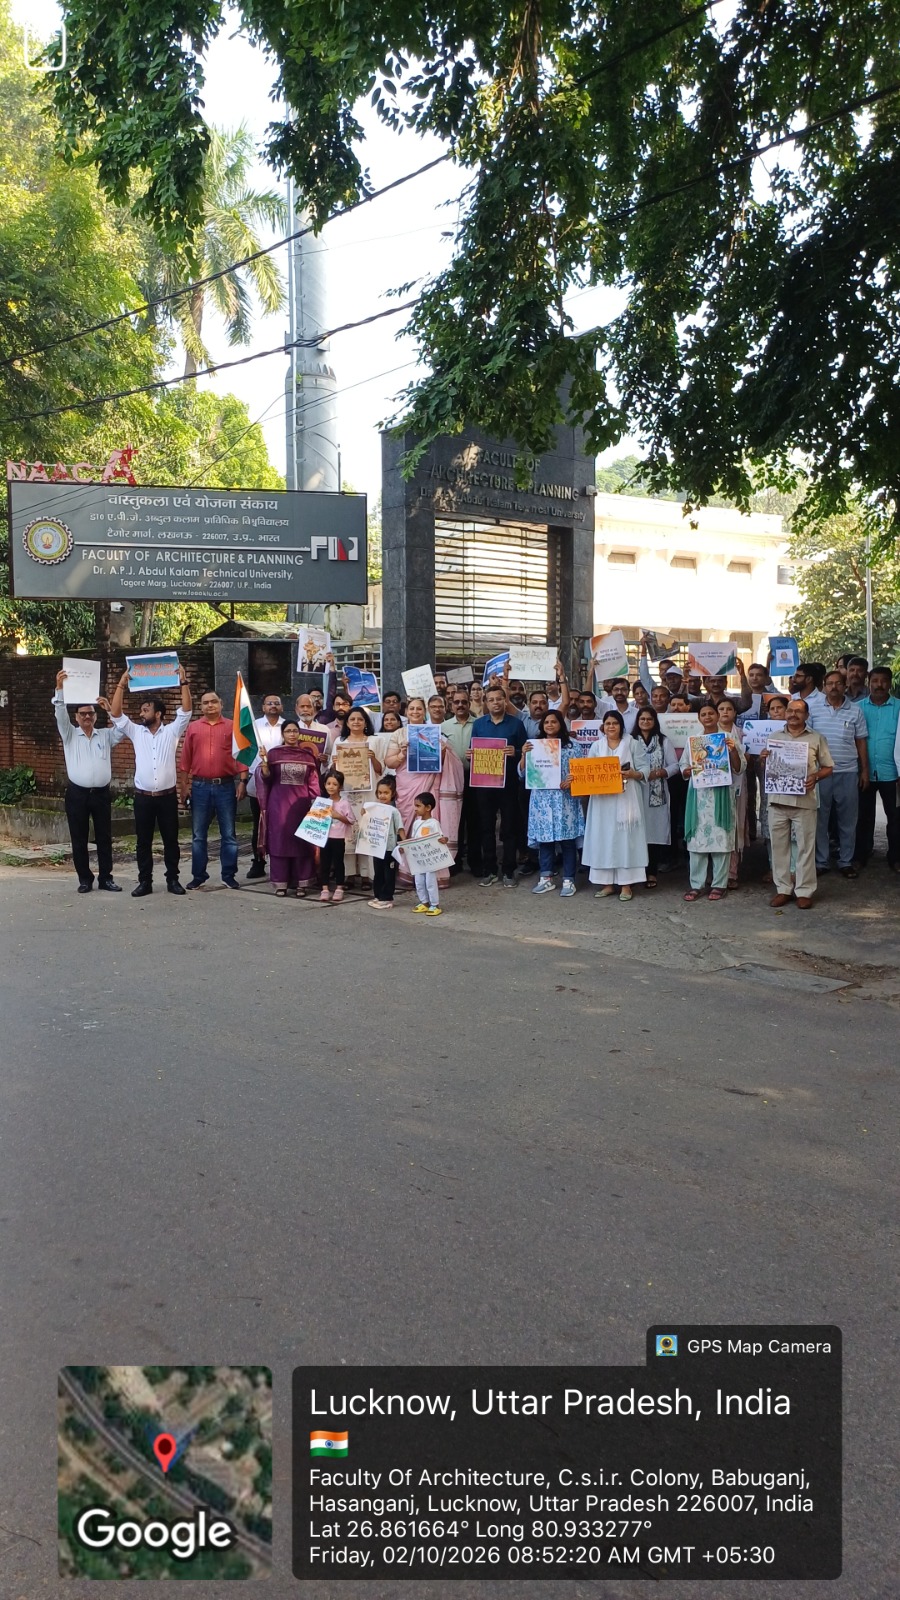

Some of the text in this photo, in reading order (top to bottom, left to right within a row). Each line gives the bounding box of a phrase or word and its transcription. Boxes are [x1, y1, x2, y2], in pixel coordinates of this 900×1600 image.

[6, 459, 93, 483] NAAC
[526, 458, 541, 473] OF
[528, 479, 579, 502] PLANNING
[108, 493, 279, 510] वास्तुकला एवं योजना संकाय
[107, 511, 142, 521] ए.पी.जे.
[145, 514, 172, 526] अब्दुल
[173, 516, 200, 524] कलाम
[204, 514, 239, 525] प्राविधिक
[242, 515, 289, 527] विश्वविद्यालय
[107, 527, 130, 538] टैगोर
[157, 531, 193, 539] लखनऊ
[258, 534, 280, 543] भारत
[82, 549, 304, 566] FACULTY OF ARCHITECTURE & PLANNING
[93, 565, 106, 575] Dr.
[109, 566, 135, 576] A.P.J.
[138, 566, 167, 576] Abdul
[169, 567, 200, 577] Kalam
[203, 568, 248, 579] Technical
[120, 579, 145, 588] Tagore
[170, 580, 202, 588] Lucknow
[254, 582, 272, 590] India
[298, 732, 325, 744] ANKALP
[577, 727, 599, 737] परंपरा
